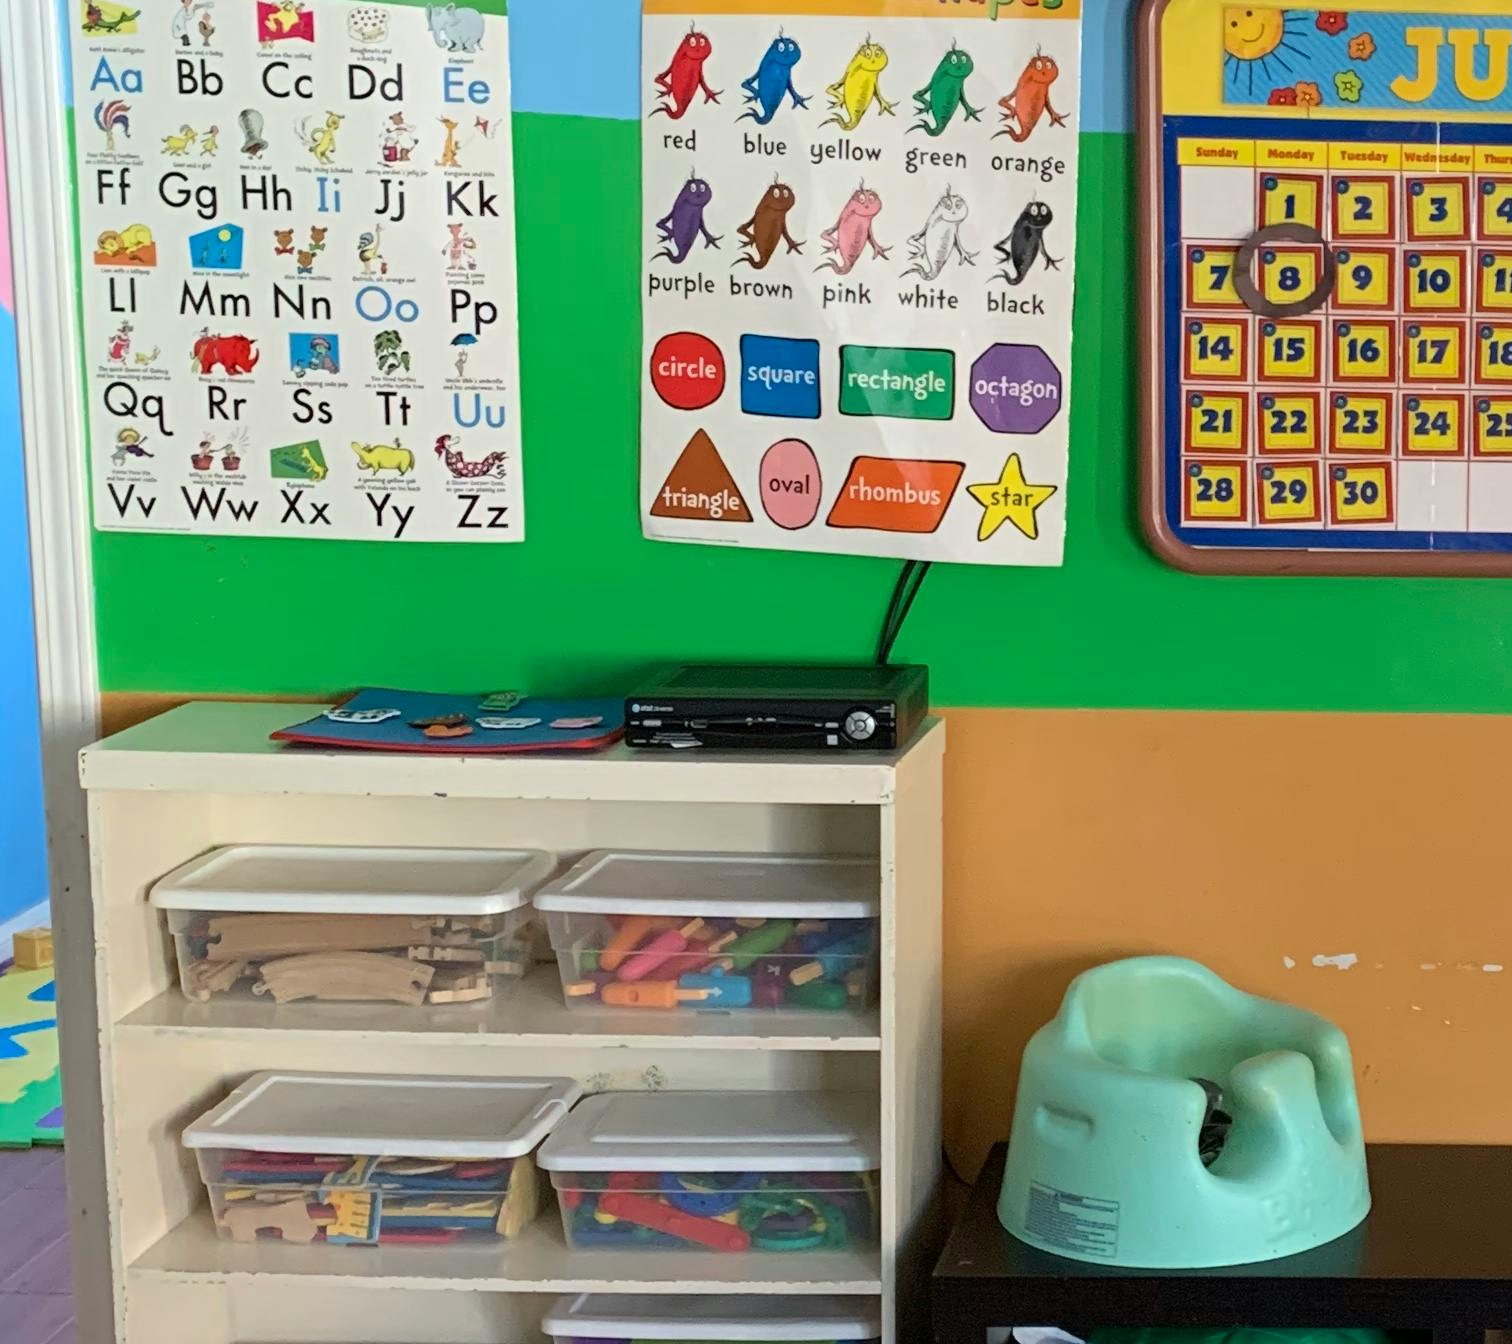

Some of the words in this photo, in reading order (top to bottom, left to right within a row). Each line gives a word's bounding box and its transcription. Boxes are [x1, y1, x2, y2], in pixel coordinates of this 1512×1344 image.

[90, 58, 143, 93] Aa
[443, 67, 490, 103] Ee
[664, 130, 696, 151] red
[744, 135, 787, 156] blue
[810, 139, 881, 164] yellow
[905, 148, 967, 173] green
[991, 154, 1066, 182] orange
[1196, 147, 1239, 162] Sunday
[1267, 148, 1314, 163] Monday
[1340, 150, 1389, 165] Tuesday
[1404, 151, 1471, 166] Wednesday
[159, 172, 218, 219] Gg
[1284, 194, 1297, 218] 1
[1352, 196, 1373, 220] 2
[1428, 197, 1448, 222] 3
[649, 273, 715, 298] purple
[730, 277, 793, 299] brown
[1278, 266, 1301, 289] 8
[823, 282, 871, 308] pink
[898, 285, 959, 310] white
[987, 292, 1045, 316] black
[658, 357, 716, 379] circle
[748, 364, 816, 390] square
[848, 370, 946, 401] rectangle
[975, 379, 1057, 407] octagon
[104, 382, 173, 436] Qq
[769, 475, 810, 495] oval
[849, 477, 941, 506] rhombus
[662, 486, 740, 518] triangle
[991, 489, 1034, 508] star
[456, 495, 508, 529] Zz
